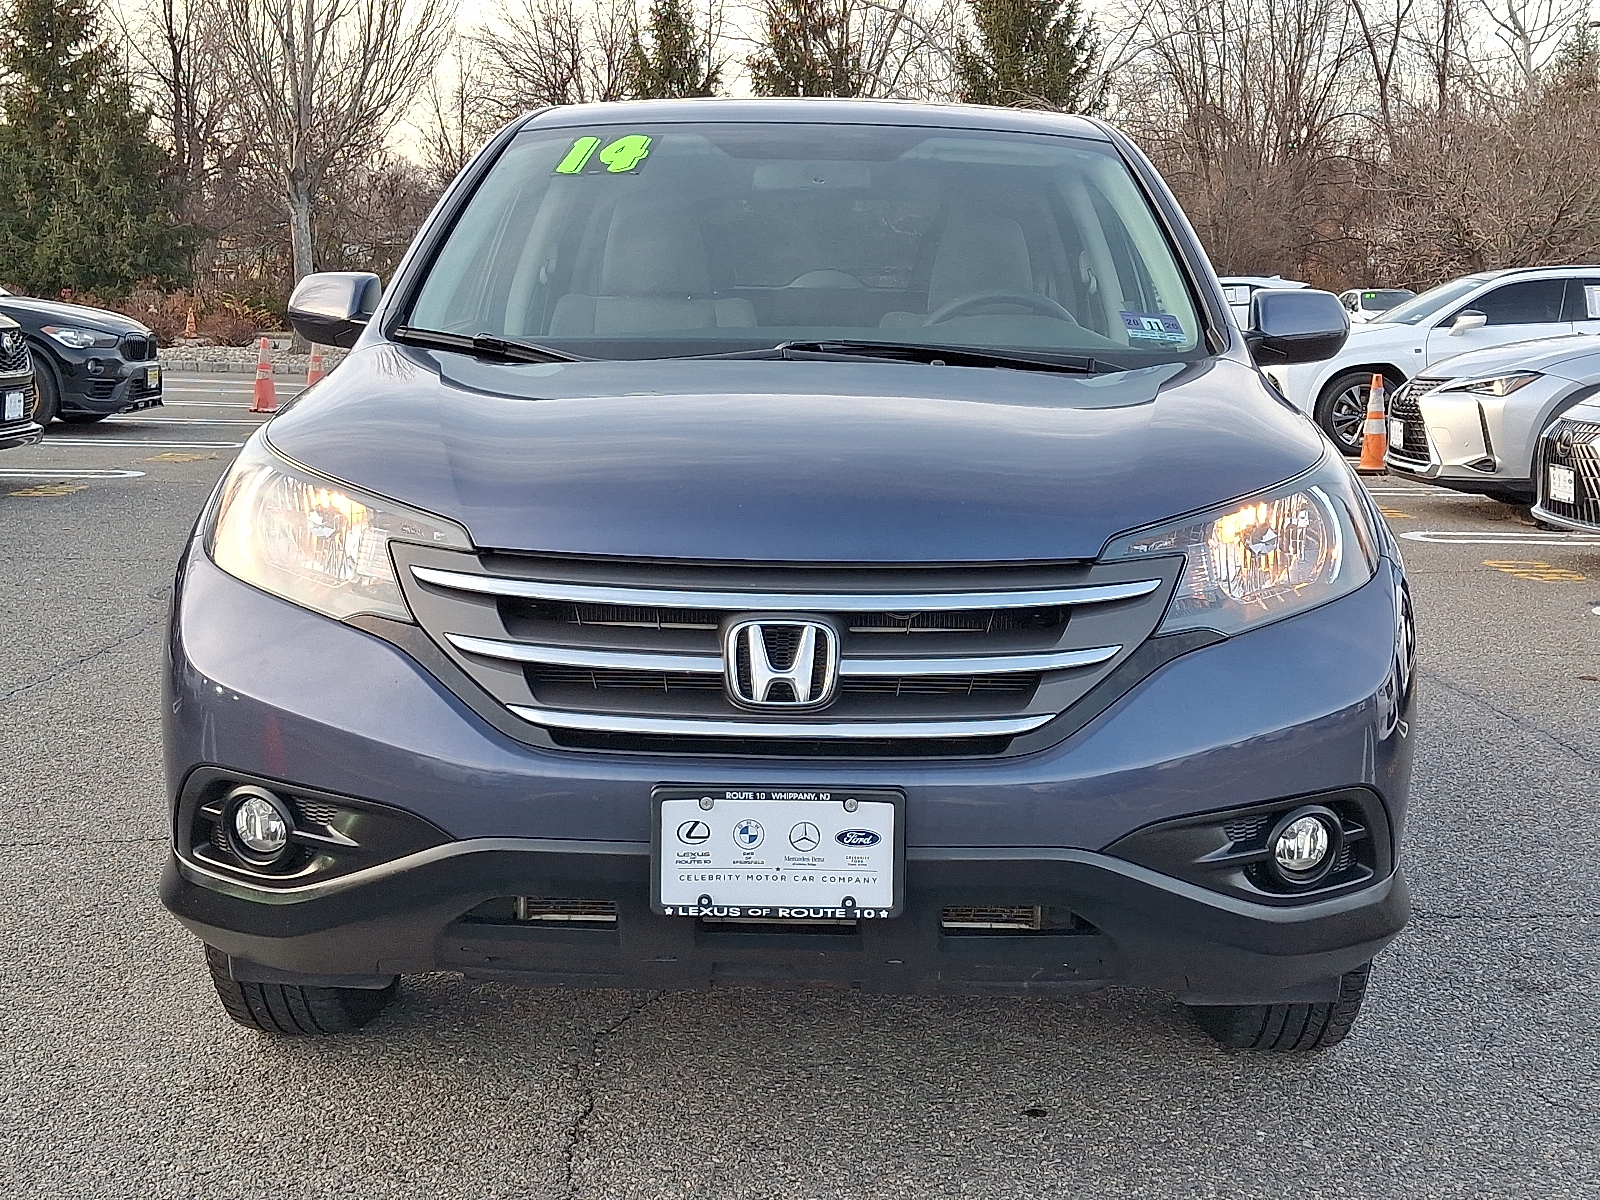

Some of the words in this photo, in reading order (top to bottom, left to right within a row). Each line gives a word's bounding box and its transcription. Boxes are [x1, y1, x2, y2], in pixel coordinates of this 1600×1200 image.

[555, 135, 653, 174] 14
[1126, 318, 1140, 326] 20
[1147, 320, 1163, 332] 11
[725, 791, 753, 800] ROUTE
[755, 791, 766, 800] 10
[771, 792, 818, 801] WHIPPANY,
[819, 793, 831, 801] NJ
[843, 831, 873, 845] Ford
[679, 874, 741, 882] CELEBRITY
[793, 875, 815, 883] CAR
[821, 875, 878, 884] COMPANY
[678, 907, 741, 916] LEXUS
[747, 908, 771, 916] OF
[778, 908, 847, 918] ROUTE
[853, 909, 876, 918] 10
